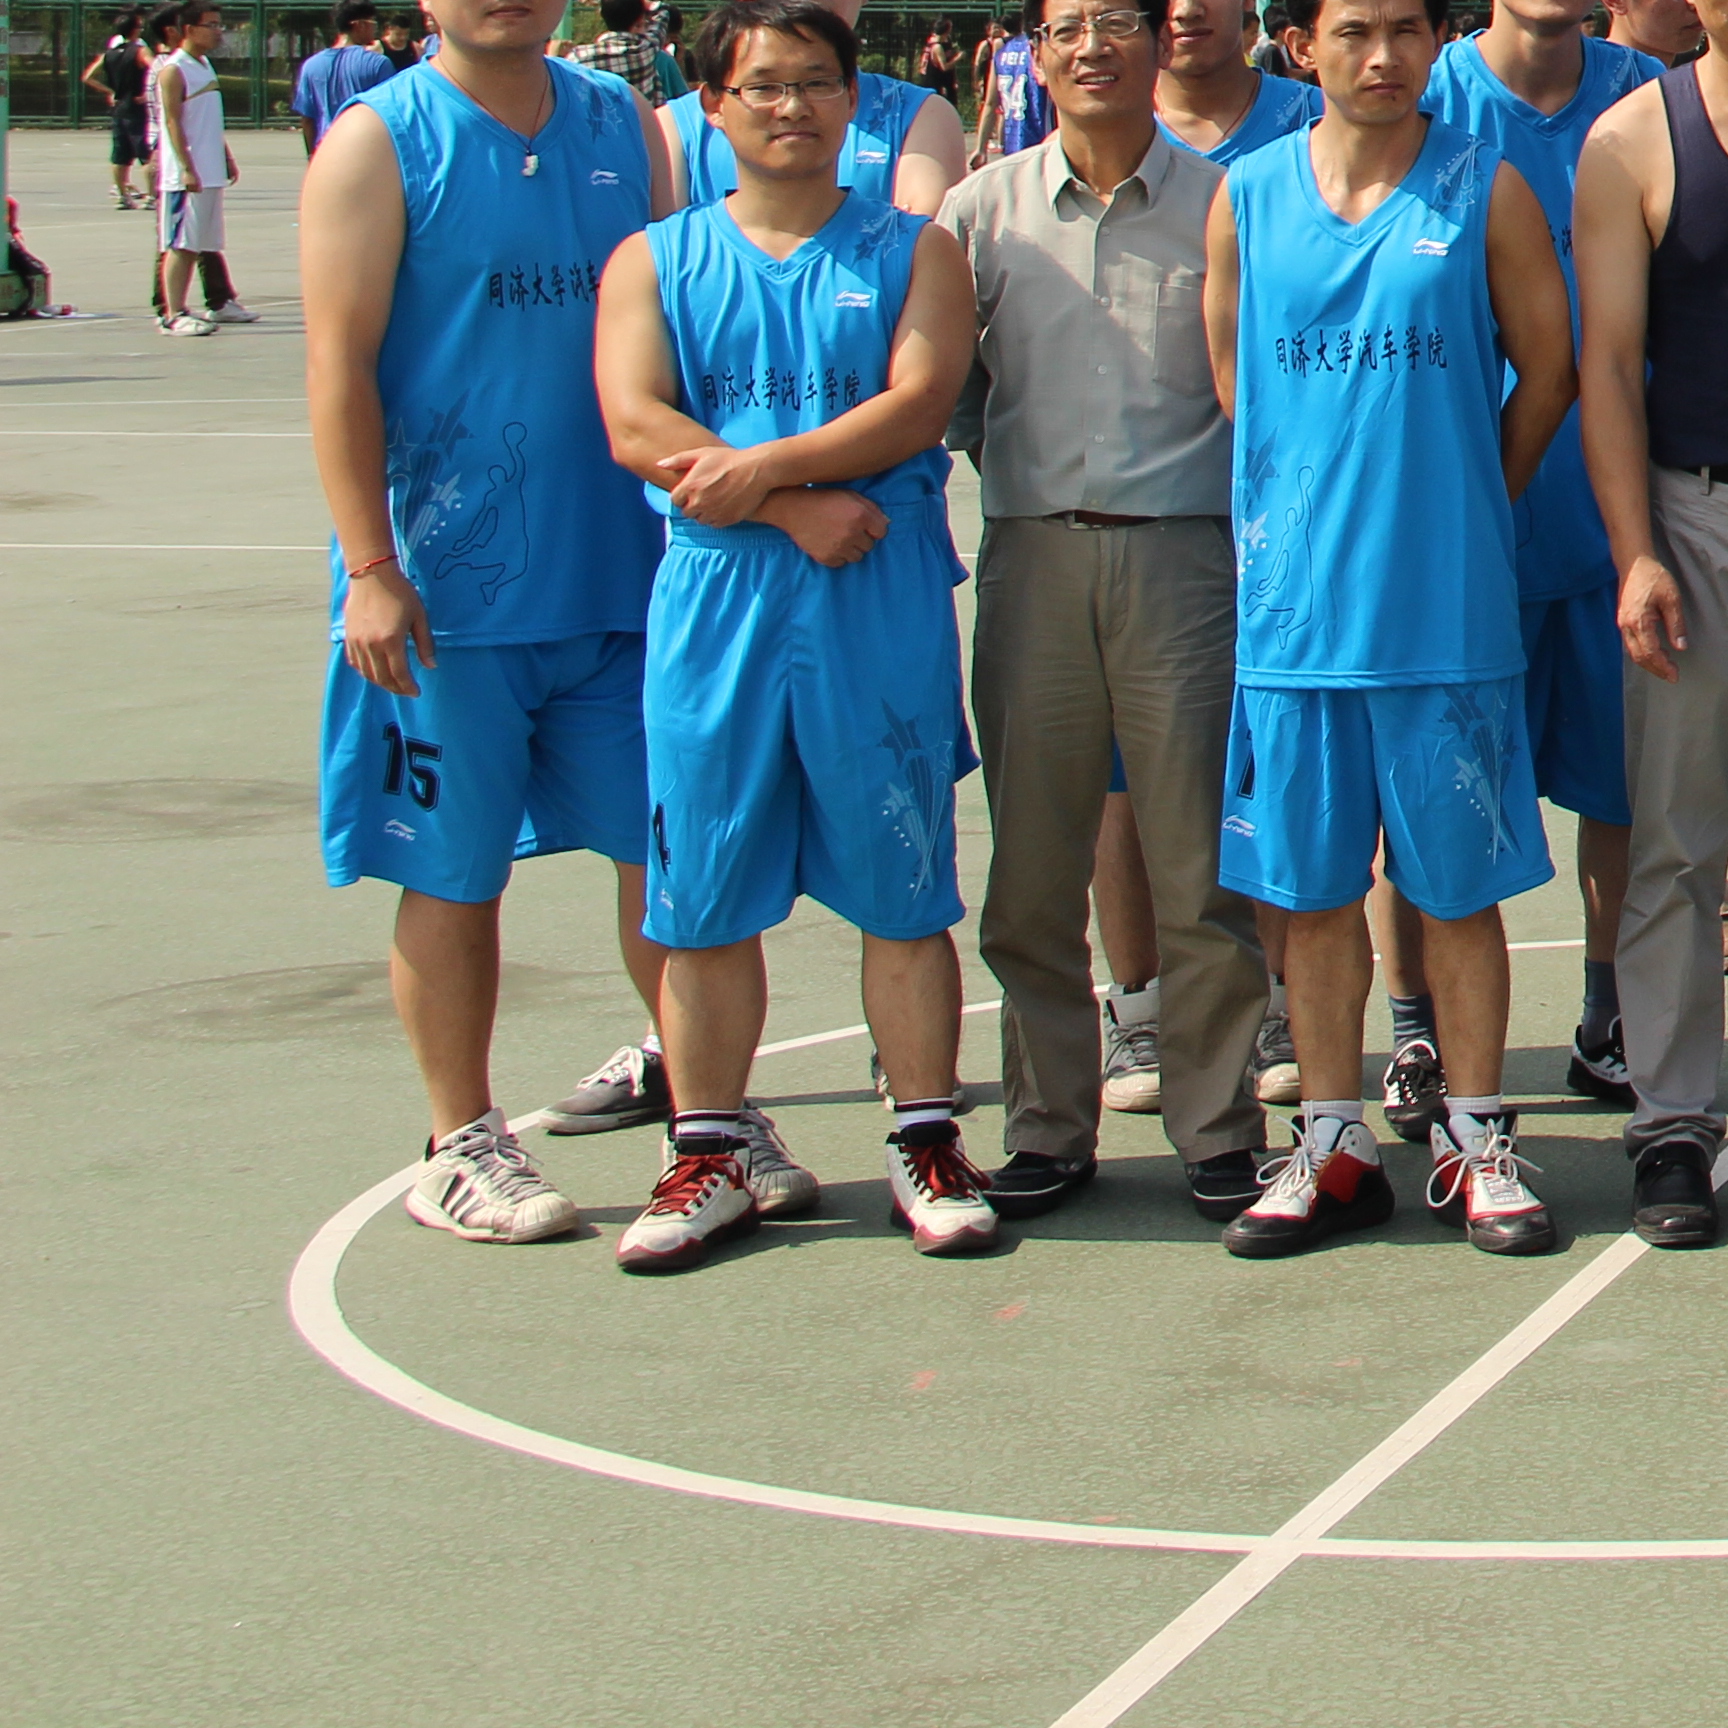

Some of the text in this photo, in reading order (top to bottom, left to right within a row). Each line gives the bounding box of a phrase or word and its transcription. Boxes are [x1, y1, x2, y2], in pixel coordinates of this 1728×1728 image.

[702, 365, 863, 412] 同济大学汽车学院
[382, 720, 443, 812] 15
